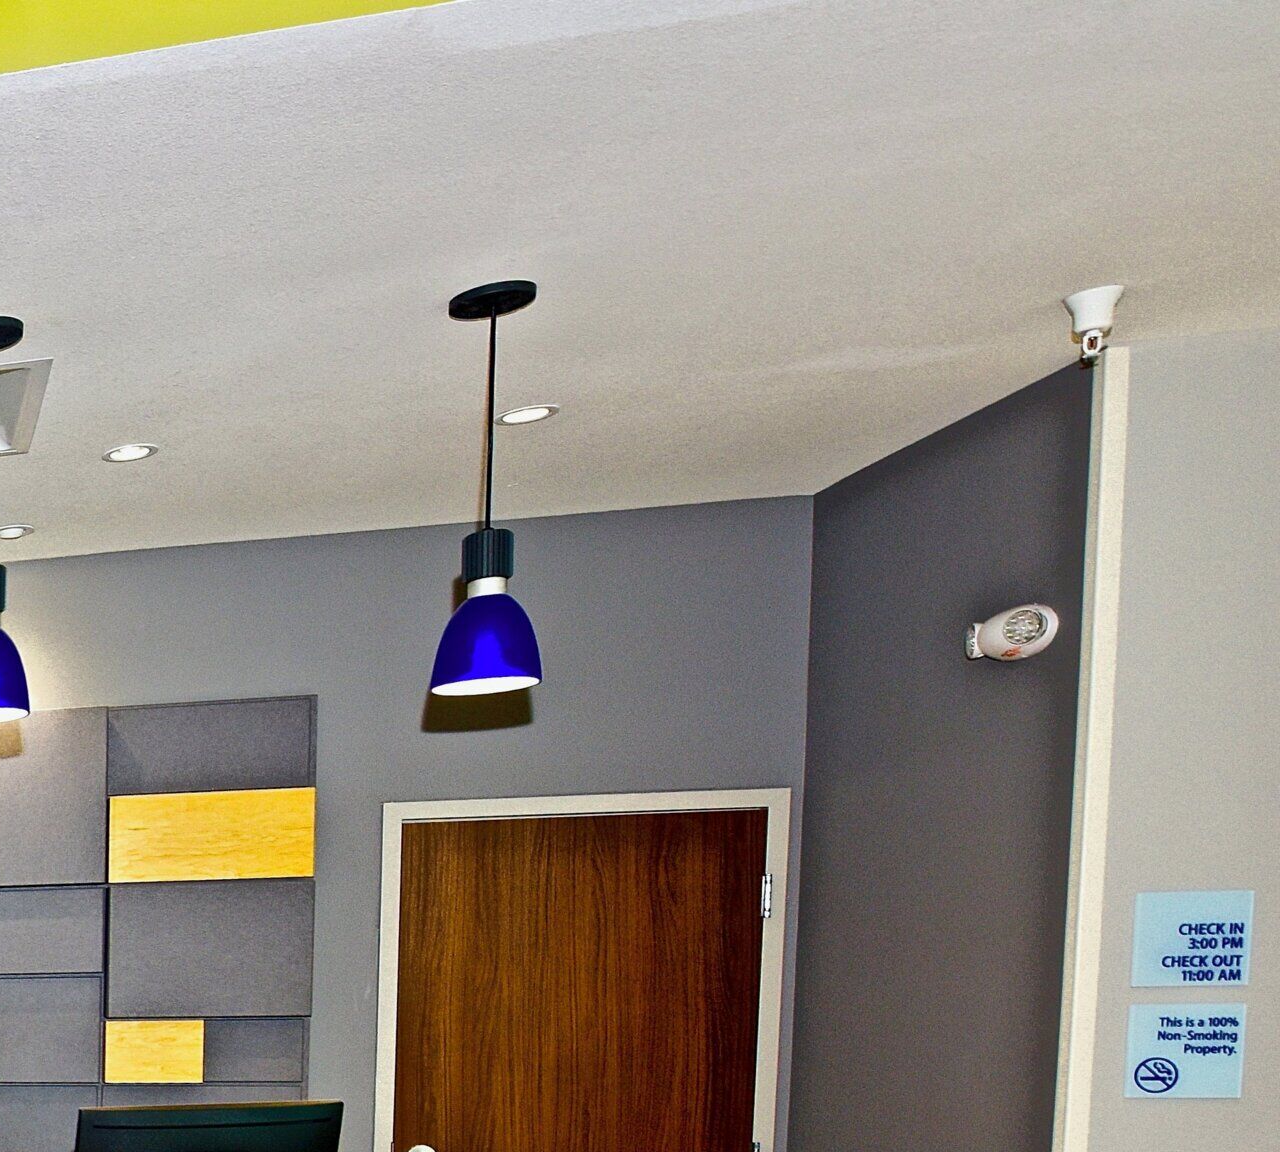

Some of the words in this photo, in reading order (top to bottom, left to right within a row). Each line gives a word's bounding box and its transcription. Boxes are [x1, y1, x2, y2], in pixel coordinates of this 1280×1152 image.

[1178, 923, 1226, 936] CHECK
[1229, 922, 1245, 935] IN
[1187, 937, 1217, 950] 3:00
[1221, 936, 1244, 949] PM
[1161, 955, 1209, 968] CHECK
[1211, 954, 1244, 967] OUT
[1181, 969, 1214, 982] 11:00
[1217, 969, 1242, 982] AM
[1159, 1016, 1183, 1027] This
[1185, 1016, 1195, 1027] is
[1197, 1019, 1204, 1027] a
[1208, 1016, 1239, 1027] 100%
[1157, 1030, 1238, 1043] Non-Smoking
[1183, 1043, 1237, 1057] Property.
